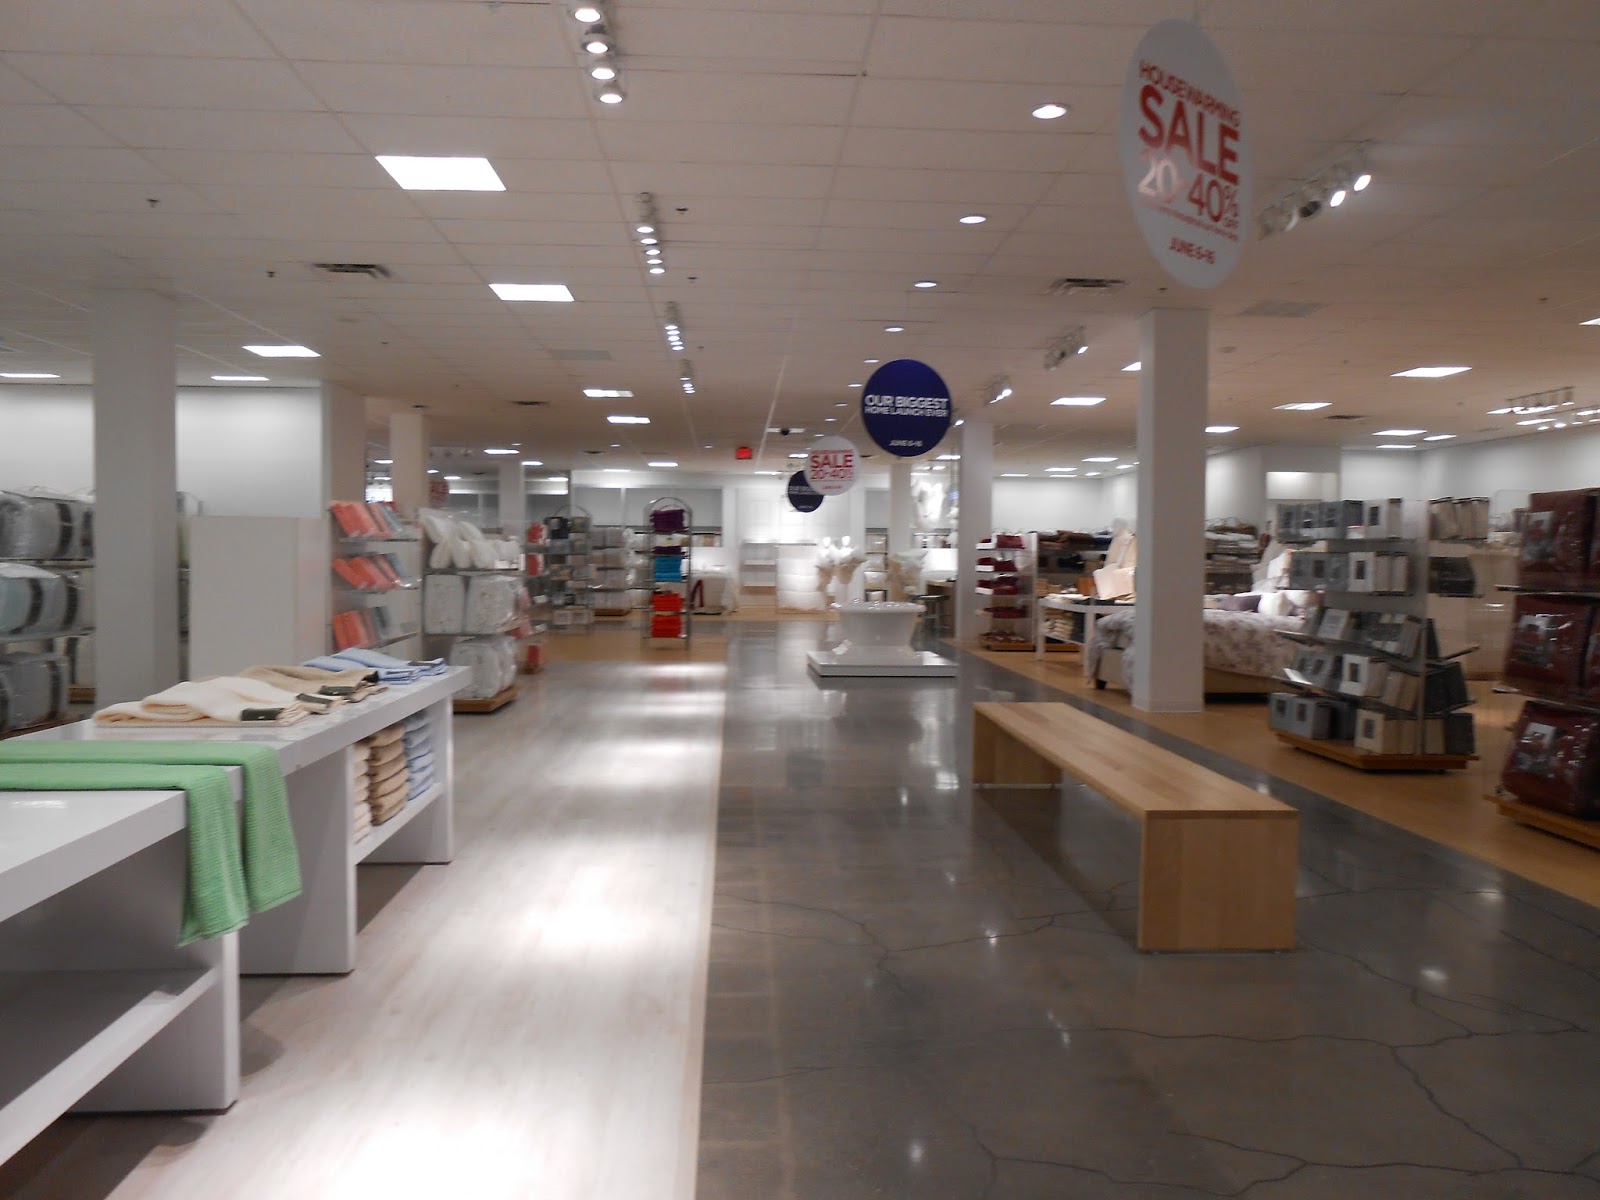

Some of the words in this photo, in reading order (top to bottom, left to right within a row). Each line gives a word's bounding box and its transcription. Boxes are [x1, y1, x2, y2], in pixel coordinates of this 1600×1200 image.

[1138, 84, 1240, 186] SALE
[1169, 237, 1196, 257] JUNE
[864, 394, 894, 407] OUR
[894, 396, 949, 409] BIGGEST
[864, 406, 890, 415] HOME
[810, 453, 853, 468] SALE
